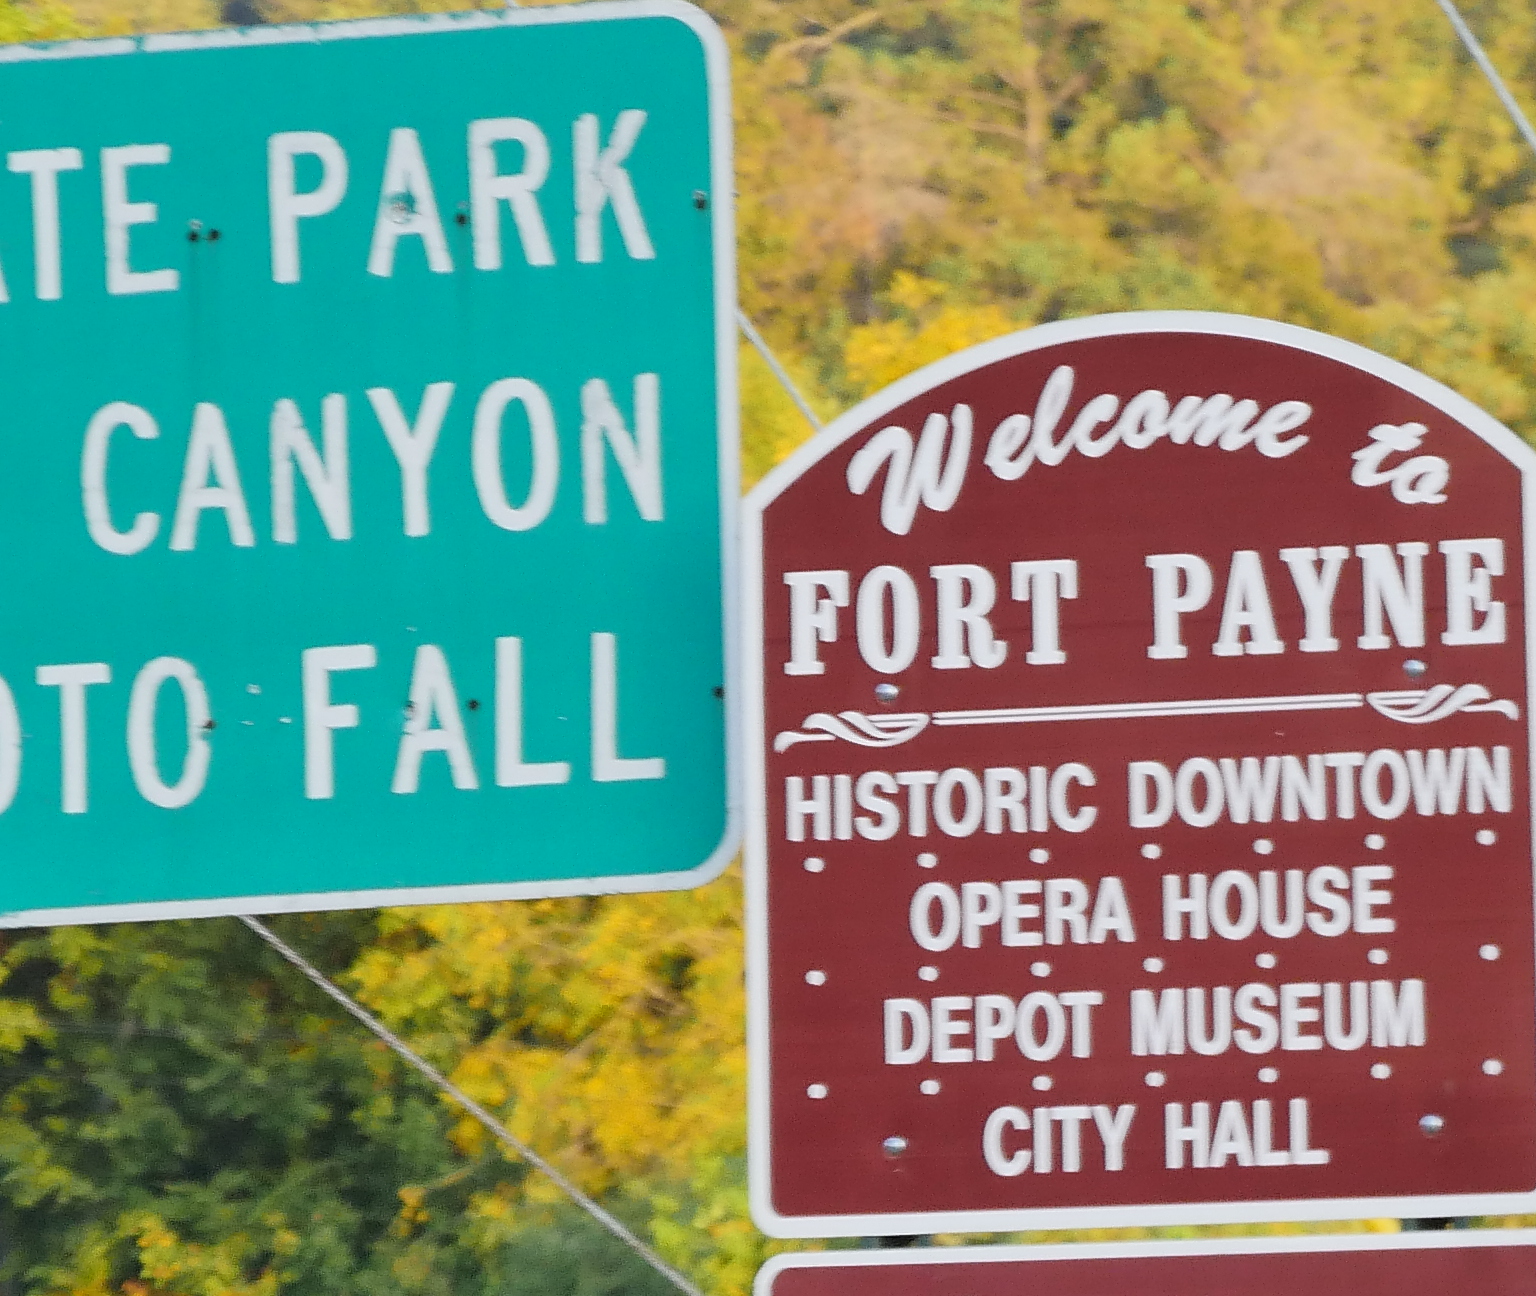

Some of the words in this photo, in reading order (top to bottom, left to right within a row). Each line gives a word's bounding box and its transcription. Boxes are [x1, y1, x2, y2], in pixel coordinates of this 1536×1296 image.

[0, 144, 179, 302] TE
[268, 109, 655, 284] PARK
[81, 373, 664, 555] CANYON
[846, 365, 1312, 536] Welcome
[1351, 422, 1450, 506] to
[783, 559, 1079, 676] FORT
[1145, 538, 1506, 660] PAYNE
[0, 656, 211, 815] TO
[302, 632, 665, 800] FALL
[785, 762, 1098, 843] HISTORIC
[1128, 746, 1512, 830] DOWNTOWN
[910, 876, 1135, 952] OPERA
[1162, 864, 1396, 941] HOUSE
[884, 991, 1104, 1065] DEPOT
[1130, 979, 1427, 1056] MUSEUM
[983, 1104, 1136, 1178] CITY
[1165, 1098, 1330, 1170] HALL
